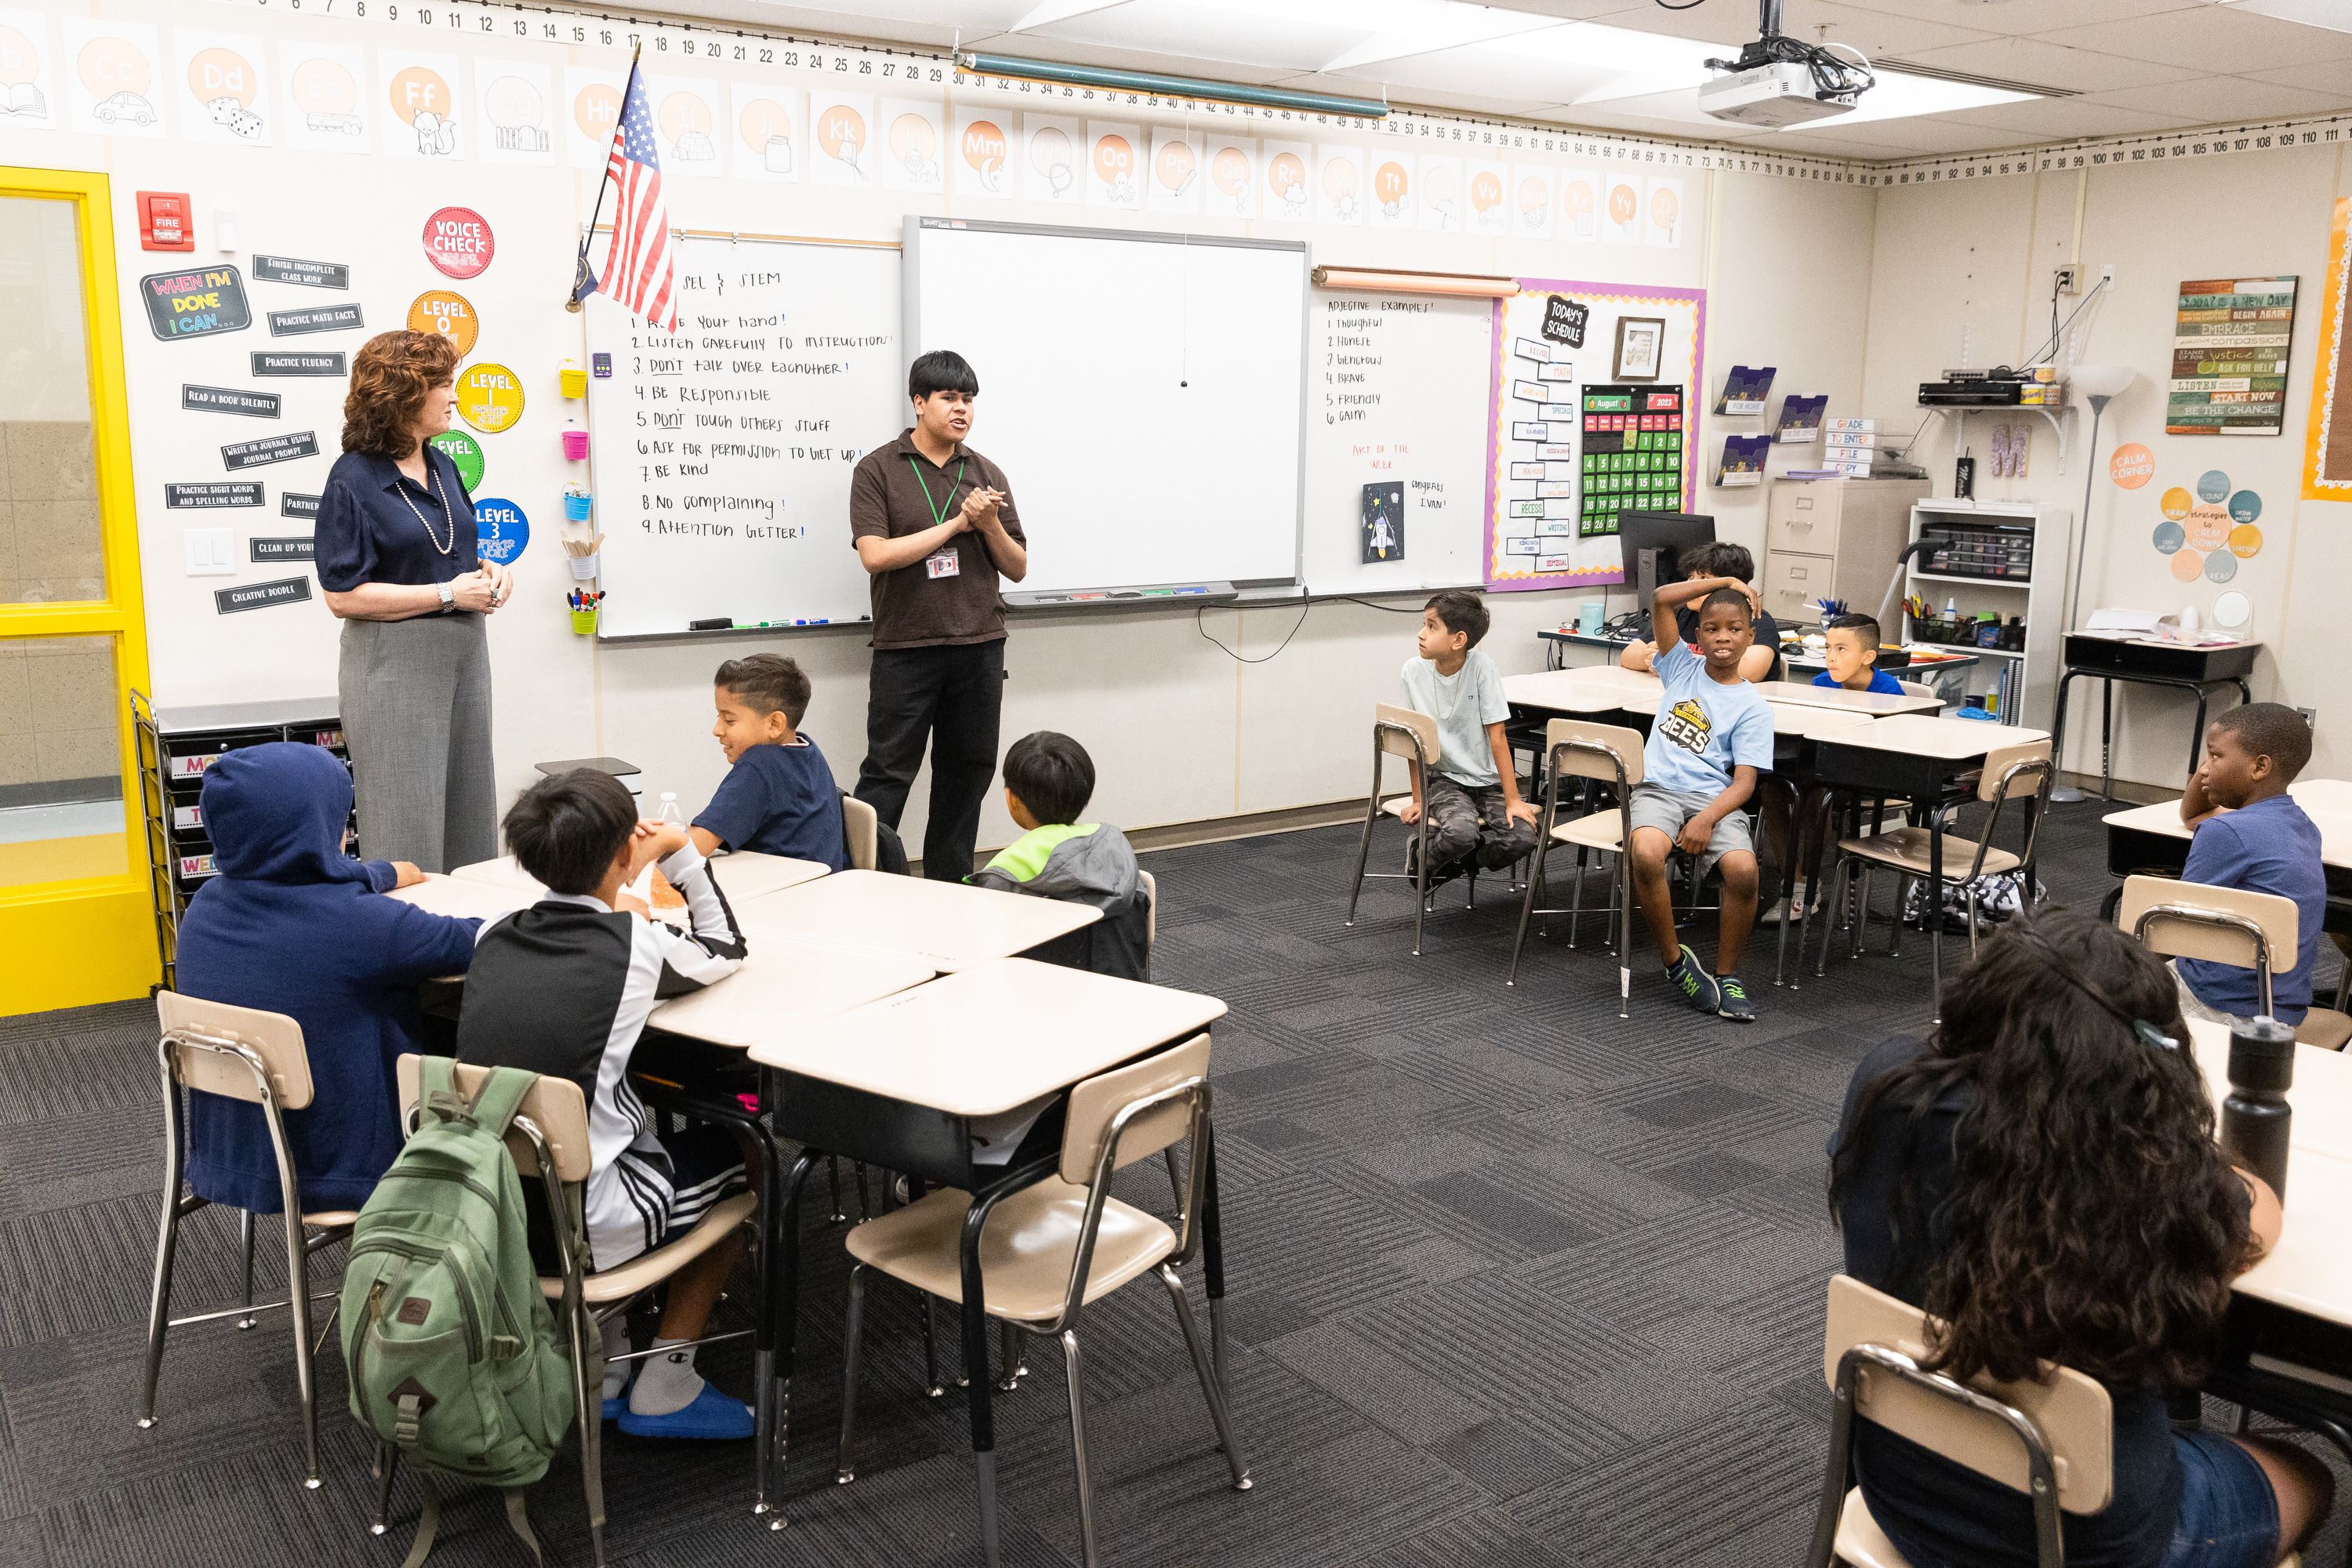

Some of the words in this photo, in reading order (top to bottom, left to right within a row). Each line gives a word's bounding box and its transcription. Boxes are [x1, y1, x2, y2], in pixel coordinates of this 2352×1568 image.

[417, 9, 432, 25] 10
[572, 27, 584, 42] 15
[655, 37, 667, 52] 18
[707, 42, 721, 57] 20
[835, 57, 848, 72] 25
[405, 81, 437, 108] Ff
[829, 118, 857, 142] Kk
[1421, 125, 1429, 136] 54
[966, 132, 1005, 157] Mm
[2092, 153, 2107, 165] 100
[2172, 145, 2187, 157] 104
[2255, 136, 2271, 148] 108
[1102, 147, 1128, 168] Oo
[1385, 172, 1400, 191] Tt
[1615, 197, 1632, 216] Yy
[156, 218, 179, 228] FIRE
[435, 220, 481, 238] VOICE
[433, 235, 486, 253] CHECK
[267, 258, 292, 270] FINISH
[295, 262, 336, 275] INCOMPLETE
[151, 275, 204, 296] WHEN
[205, 270, 231, 287] I'M
[281, 272, 301, 282] CLASS
[303, 275, 322, 284] WORK
[683, 275, 706, 290] SEL
[739, 273, 780, 288] STEM
[172, 292, 221, 314] DONE
[423, 300, 468, 318] LEVEL
[1328, 301, 1370, 313] ADJECTIVE
[276, 315, 310, 327] PRACTICE
[312, 313, 333, 323] MATH
[336, 310, 356, 321] FACTS
[1552, 301, 1583, 326] TODAY'S
[2233, 310, 2256, 320] BEGIN
[2259, 309, 2286, 318] AGAIN
[169, 319, 177, 334] I
[698, 315, 731, 330] Your
[2201, 322, 2256, 335] EMBRACE
[1547, 320, 1581, 343] SCHEDULE
[631, 336, 644, 349] 2.
[778, 336, 793, 350] TO
[2211, 336, 2285, 346] compassion
[265, 357, 300, 367] PRACTICE
[302, 358, 333, 368] FLUENCY
[633, 357, 644, 375] 3.
[732, 361, 764, 373] OVER
[2218, 363, 2234, 373] ASK
[2236, 363, 2252, 373] FOR
[2254, 362, 2274, 372] HELP
[1338, 372, 1366, 384] BRAVE
[1553, 367, 1571, 378] MATH
[470, 373, 514, 390] LEVEL
[2177, 381, 2217, 390] LISTEN
[188, 390, 209, 402] READ
[210, 394, 216, 403] A
[219, 396, 239, 406] BOOK
[241, 398, 277, 410] SILENTLY
[635, 385, 647, 401] 4.
[652, 386, 668, 400] BE
[2213, 393, 2248, 403] START
[2251, 392, 2276, 401] NOW
[1656, 398, 1672, 407] 2023
[470, 405, 509, 416] PARTNER
[1552, 406, 1571, 415] SPECIALS
[2184, 407, 2199, 416] BE
[2204, 406, 2224, 415] THE
[2227, 405, 2276, 415] CHANGE
[477, 415, 503, 426] VOICE
[637, 411, 650, 426] 5.
[1837, 419, 1864, 429] GRADE
[227, 446, 248, 458] WRITE
[249, 444, 258, 452] IN
[260, 437, 289, 451] JOURNAL
[291, 433, 311, 445] USING
[1657, 437, 1664, 447] 2
[1831, 434, 1842, 443] TO
[1844, 434, 1869, 444] ENTER
[243, 452, 274, 464] JOURNAL
[275, 446, 302, 459] PROMPT
[637, 439, 650, 455] 6.
[653, 441, 675, 454] ASK
[682, 442, 702, 457] FOR
[787, 447, 804, 459] TO
[1352, 444, 1371, 457] ART
[1394, 444, 1410, 453] THE
[1840, 449, 1858, 459] FILE
[1370, 460, 1392, 470] WEEK
[1668, 457, 1678, 466] 10
[2116, 453, 2146, 467] CALM
[639, 466, 652, 482] 7.
[655, 465, 670, 477] BE
[1835, 464, 1857, 474] COPY
[2111, 463, 2153, 480] CORNER
[1639, 477, 1647, 488] 15
[176, 485, 209, 495] PRACTICE
[210, 485, 230, 494] SIGHT
[232, 485, 255, 494] WORDS
[180, 497, 194, 506] AND
[195, 496, 229, 505] SPELLING
[230, 495, 253, 504] WORDS
[287, 498, 320, 510] PARTNER
[642, 494, 653, 510] 8.
[656, 495, 673, 510] NO
[1521, 503, 1543, 514] RECESS
[476, 508, 519, 524] LEVEL
[491, 523, 500, 539] 3
[641, 519, 655, 534] 9.
[1548, 524, 1568, 532] WRITING
[259, 543, 282, 553] CLEAN
[285, 543, 296, 552] UP
[482, 548, 509, 559] VOICE
[1546, 559, 1567, 568] DISMISSAL
[232, 590, 267, 603] CREATIVE
[269, 585, 296, 597] DOODLE
[1660, 711, 1708, 753] BEES
